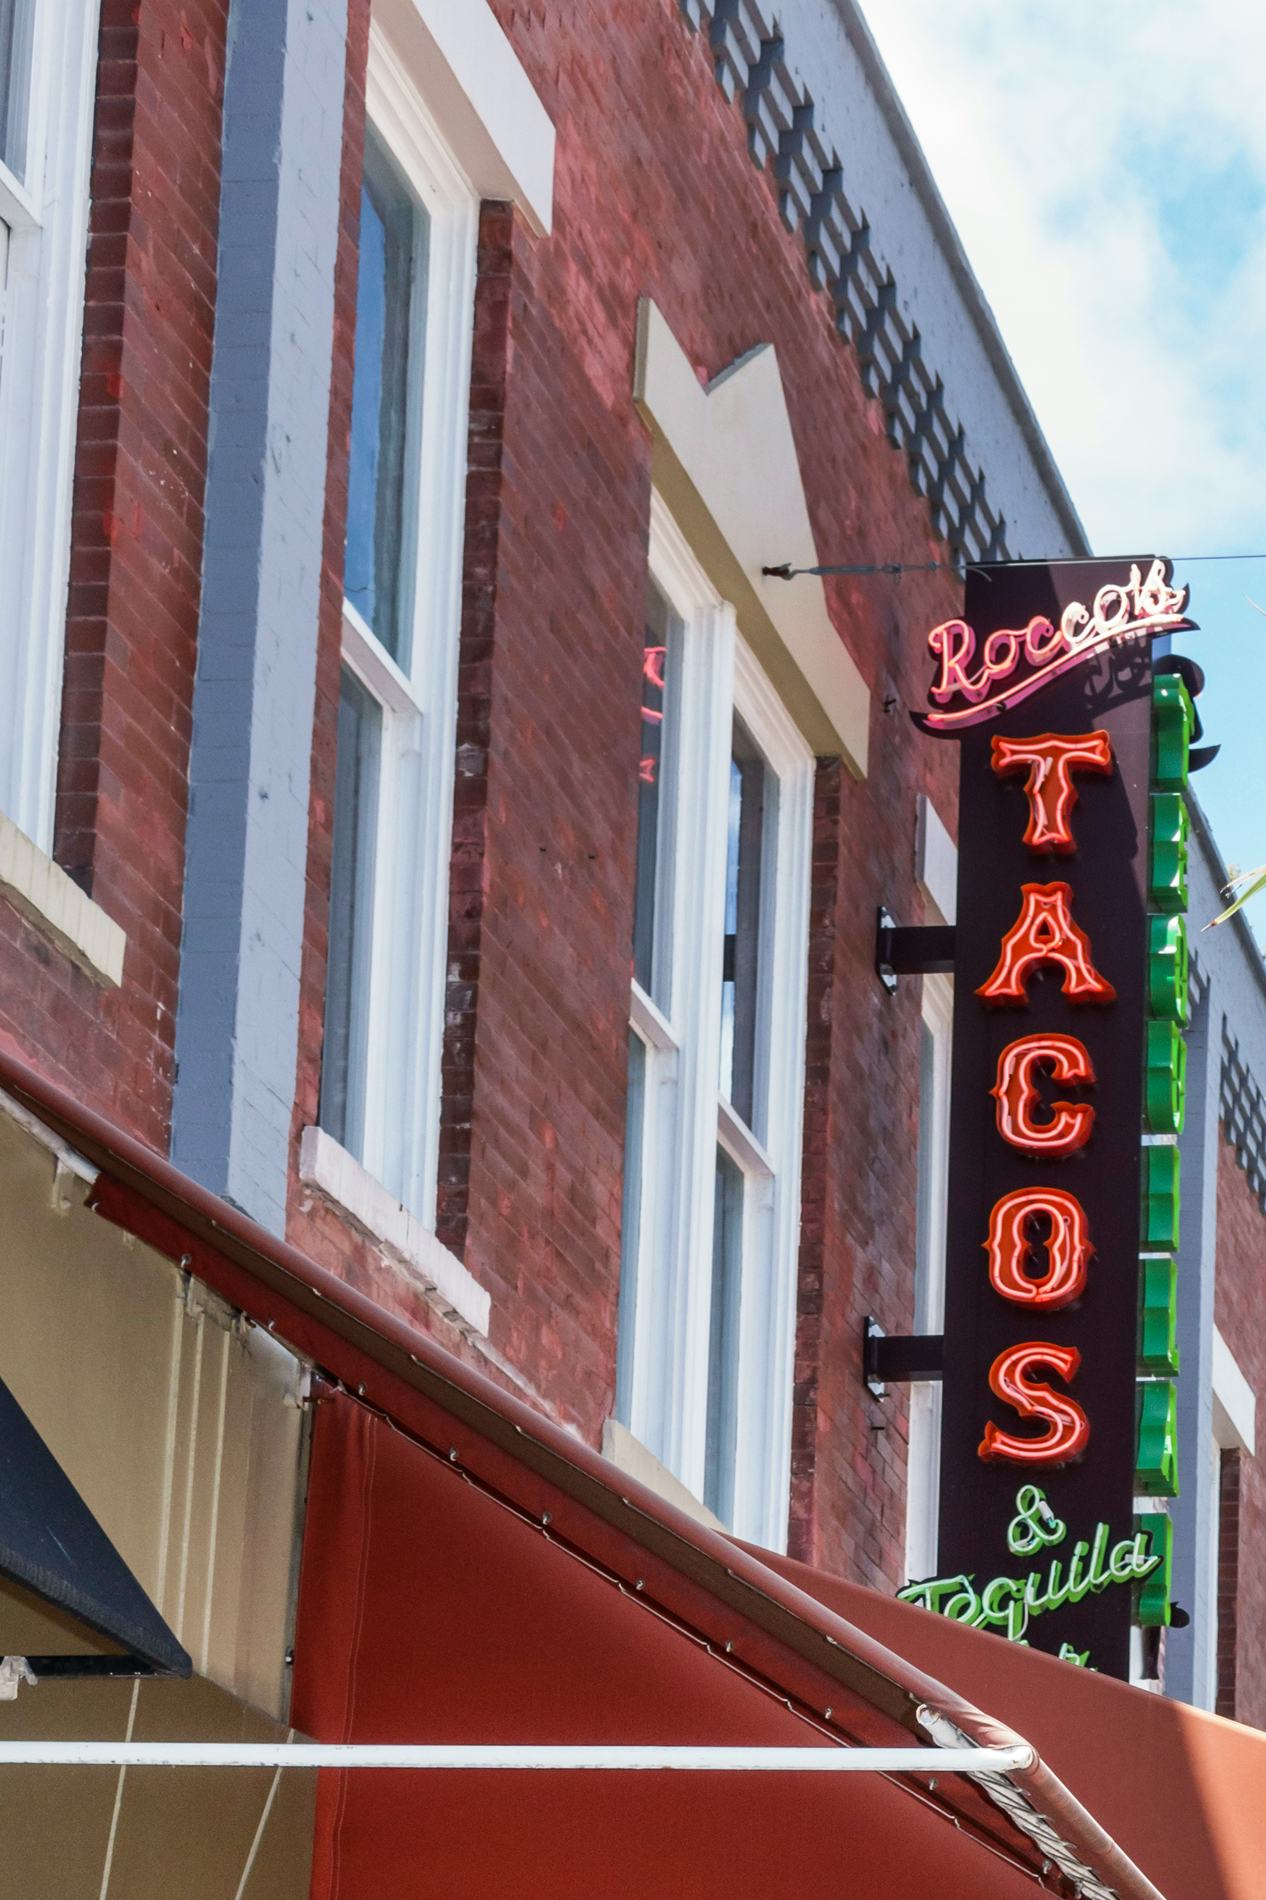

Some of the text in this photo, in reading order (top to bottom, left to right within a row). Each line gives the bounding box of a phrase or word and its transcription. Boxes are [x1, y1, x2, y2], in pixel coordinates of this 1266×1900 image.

[927, 559, 1188, 704] Rocco's
[974, 729, 1118, 1465] TACOS
[897, 1522, 1164, 1642] Tequila
[1007, 1484, 1066, 1557] &
